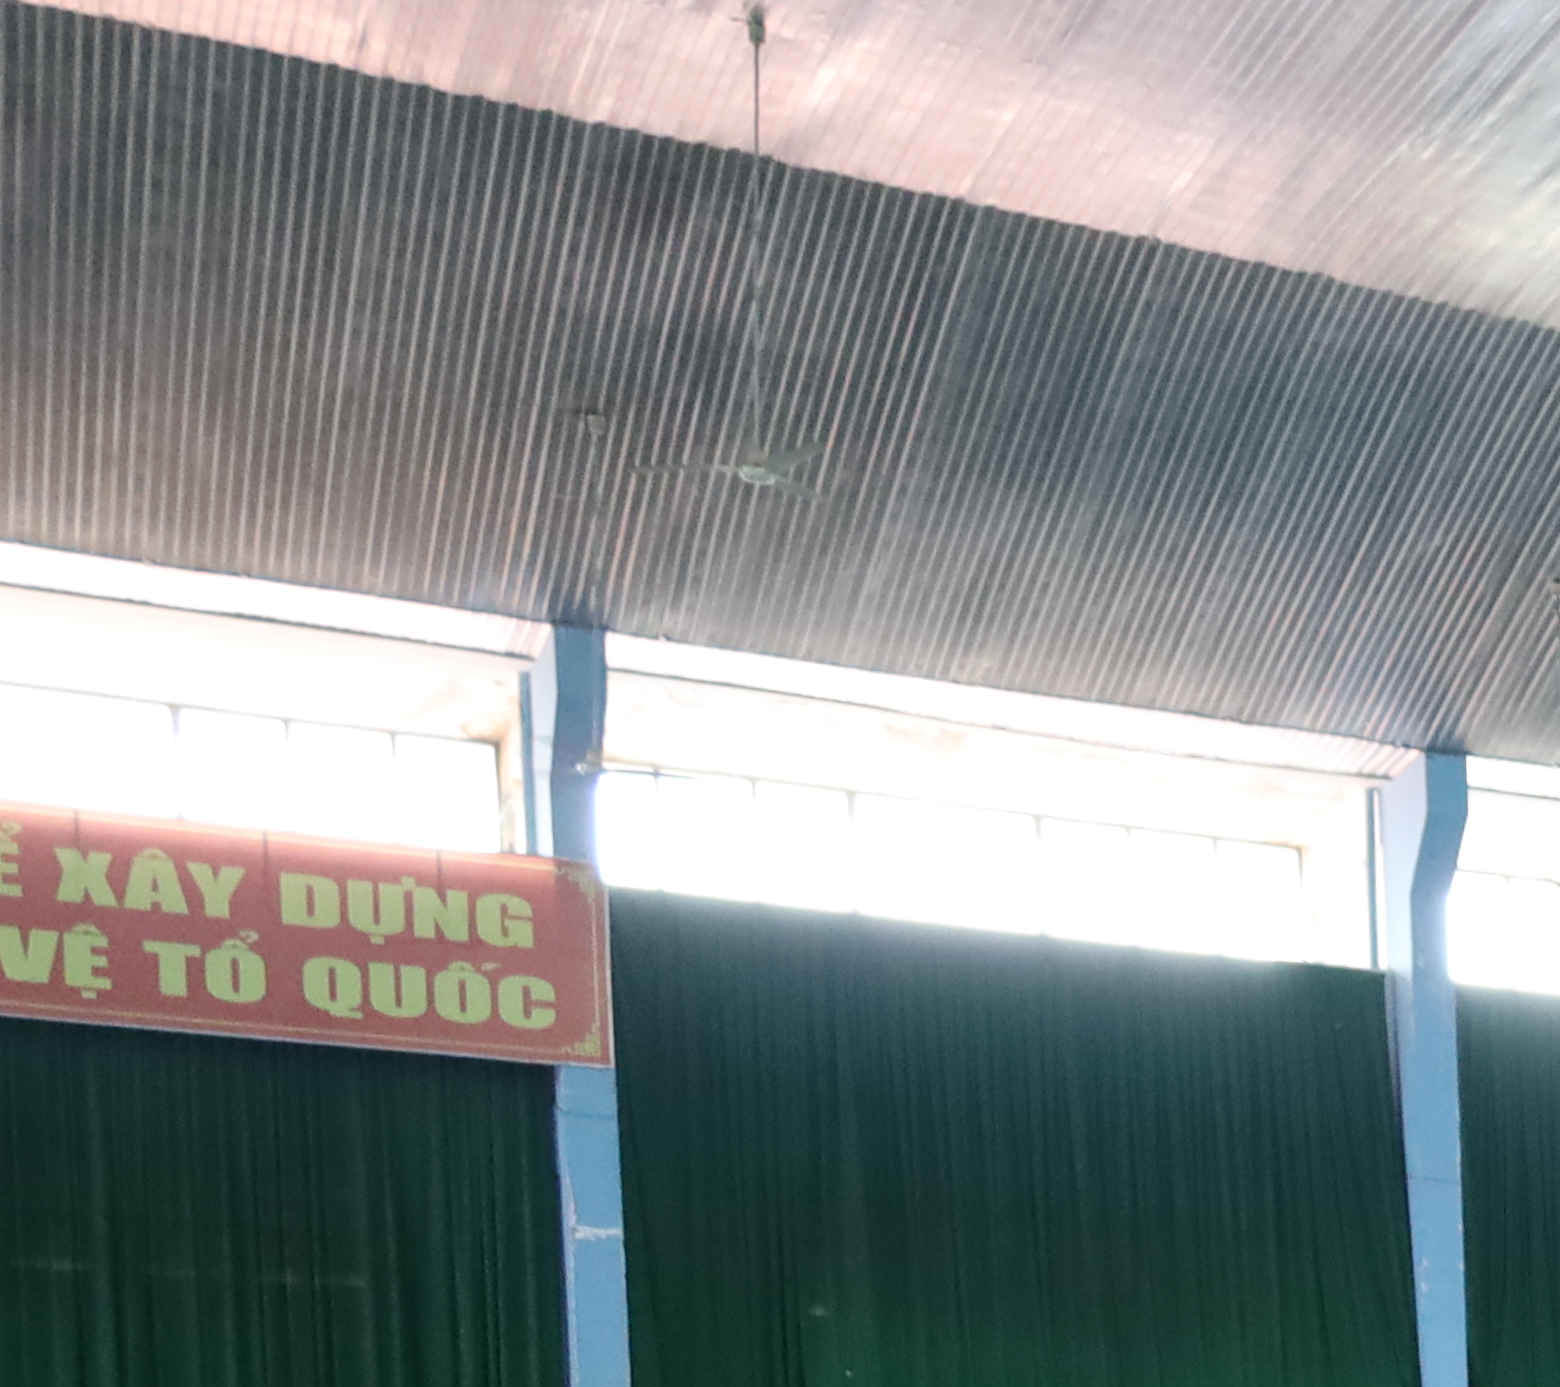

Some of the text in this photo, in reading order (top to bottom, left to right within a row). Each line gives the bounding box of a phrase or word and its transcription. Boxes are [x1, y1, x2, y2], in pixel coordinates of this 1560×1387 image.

[54, 847, 245, 919] XÂY
[278, 871, 535, 949] DỰNG
[0, 921, 557, 1030] VỆ TỔ QUỐC
